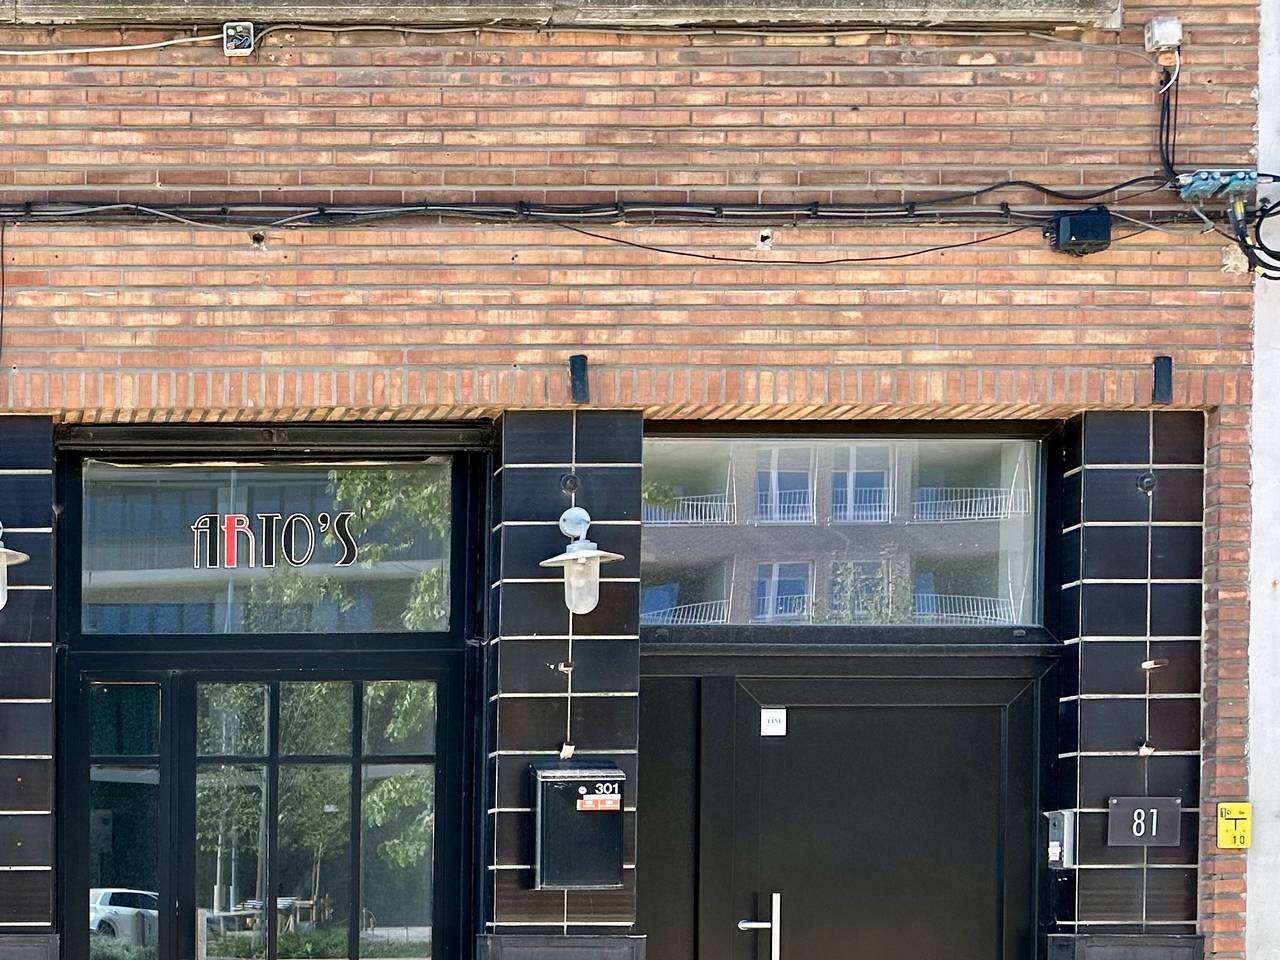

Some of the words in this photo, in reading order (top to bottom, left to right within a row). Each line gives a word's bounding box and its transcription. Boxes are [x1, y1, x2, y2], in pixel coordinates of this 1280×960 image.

[191, 512, 358, 569] ARTO'S
[595, 782, 619, 794] 301
[1132, 808, 1158, 837] 81
